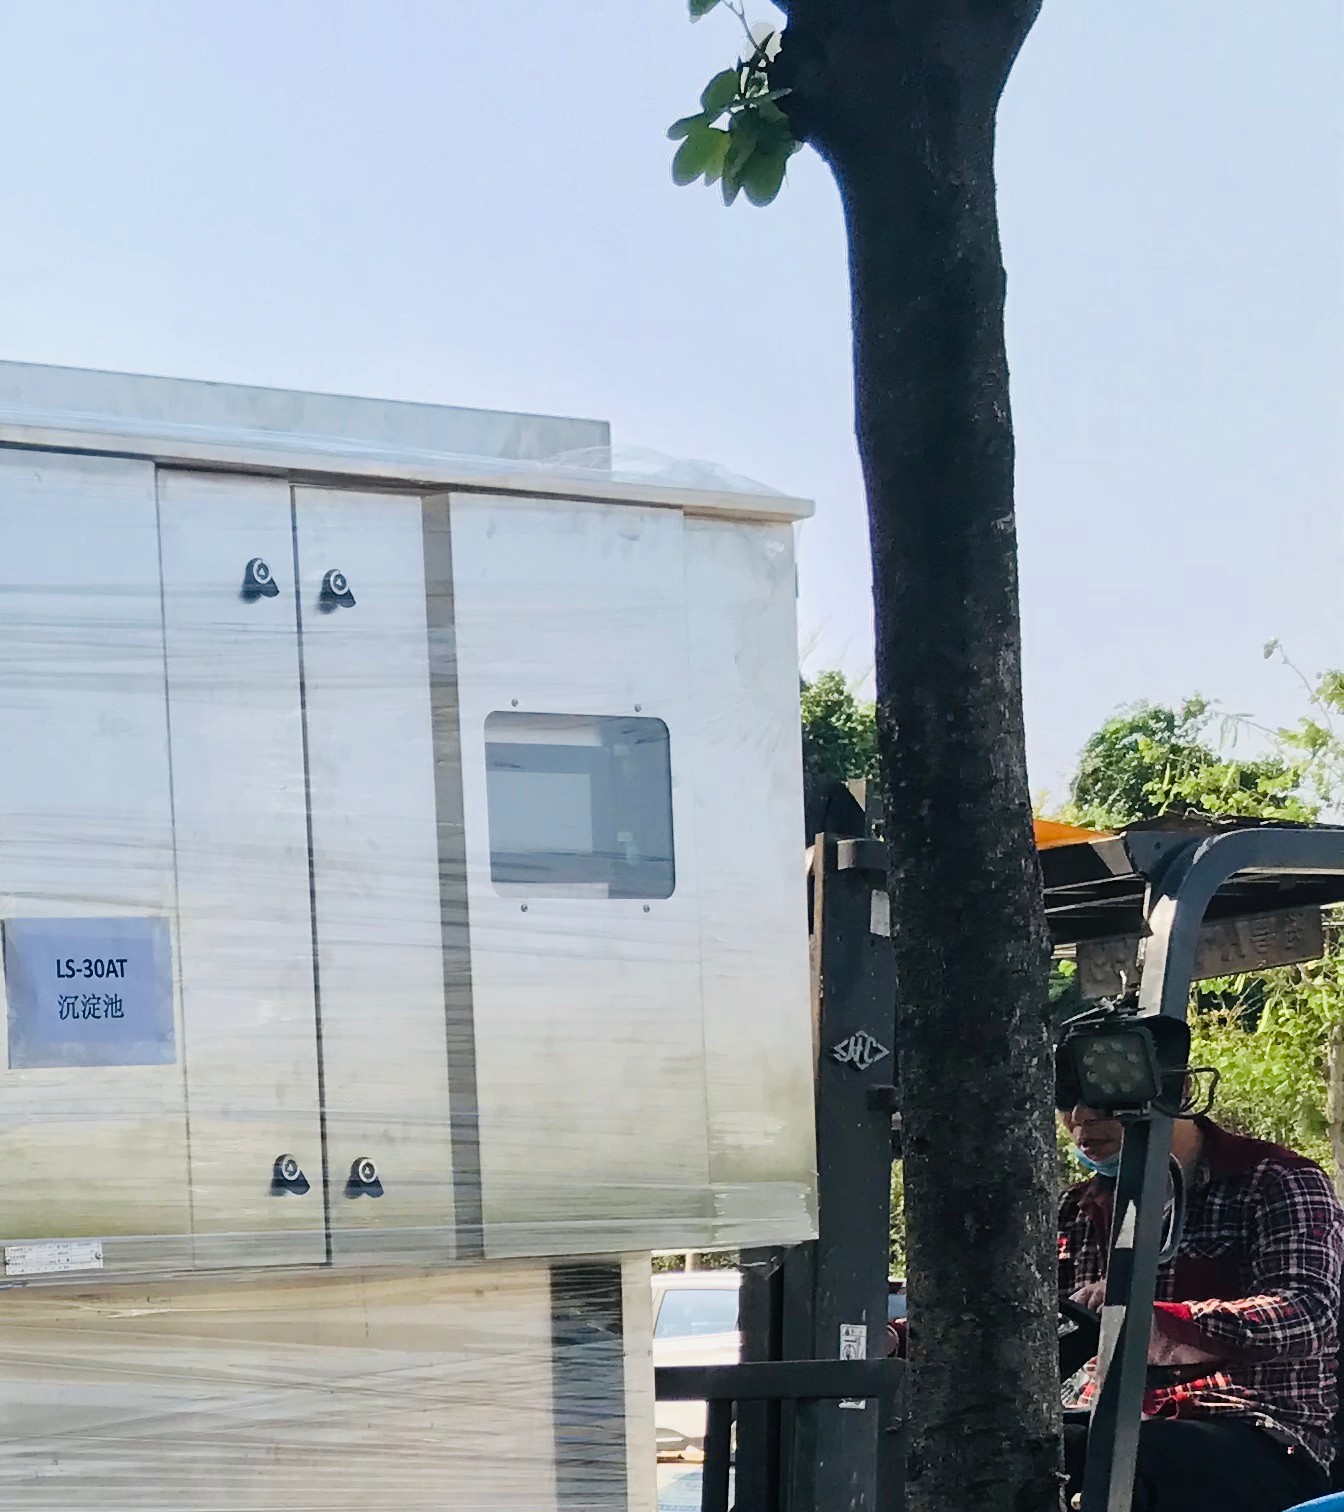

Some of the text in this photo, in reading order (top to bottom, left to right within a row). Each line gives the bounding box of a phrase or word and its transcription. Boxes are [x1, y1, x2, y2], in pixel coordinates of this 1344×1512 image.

[56, 958, 128, 979] LS-30AT
[57, 993, 125, 1020] 沉淀池
